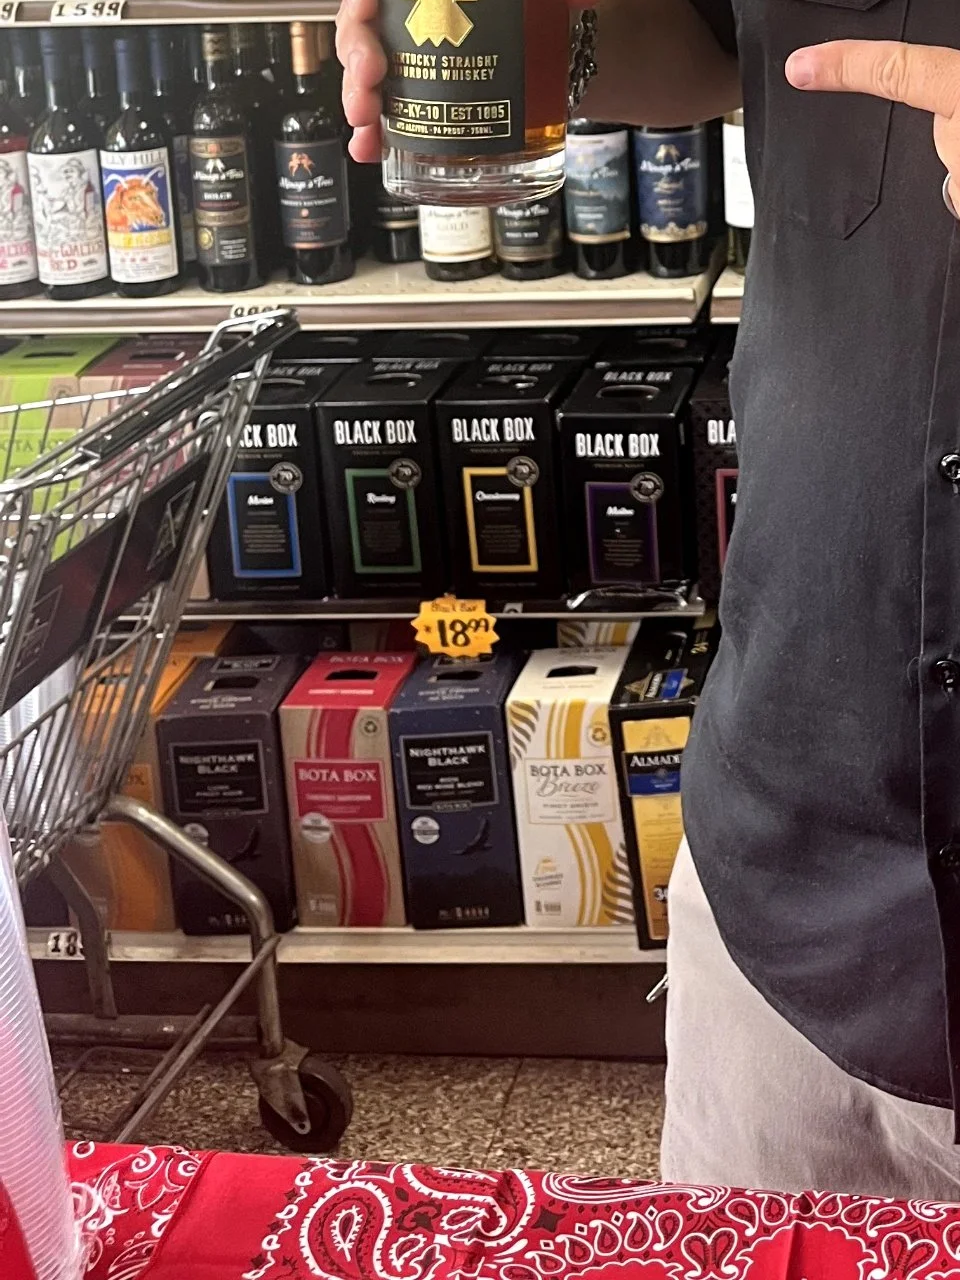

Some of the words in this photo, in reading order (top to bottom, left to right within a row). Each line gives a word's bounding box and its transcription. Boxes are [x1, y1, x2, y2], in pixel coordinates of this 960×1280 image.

[441, 54, 499, 69] STRAIGHT
[441, 68, 495, 81] WHISKEY
[450, 106, 472, 120] EST
[603, 371, 645, 382] BLACK
[646, 371, 674, 382] BOX
[267, 423, 299, 448] BOX
[333, 420, 382, 445] BLACK
[385, 419, 418, 444] BOX
[451, 418, 500, 443] BLACK
[502, 416, 536, 442] BOX
[575, 433, 625, 458] BLACK
[627, 433, 661, 457] BOX
[409, 745, 486, 758] NIGHTHAWK
[178, 753, 255, 765] NIGHTHAWK
[428, 757, 470, 768] BLACK
[197, 765, 239, 775] BLACK
[299, 769, 339, 782] BOTA
[344, 769, 377, 782] BOX
[529, 763, 570, 778] BOTA
[575, 762, 609, 776] BOX
